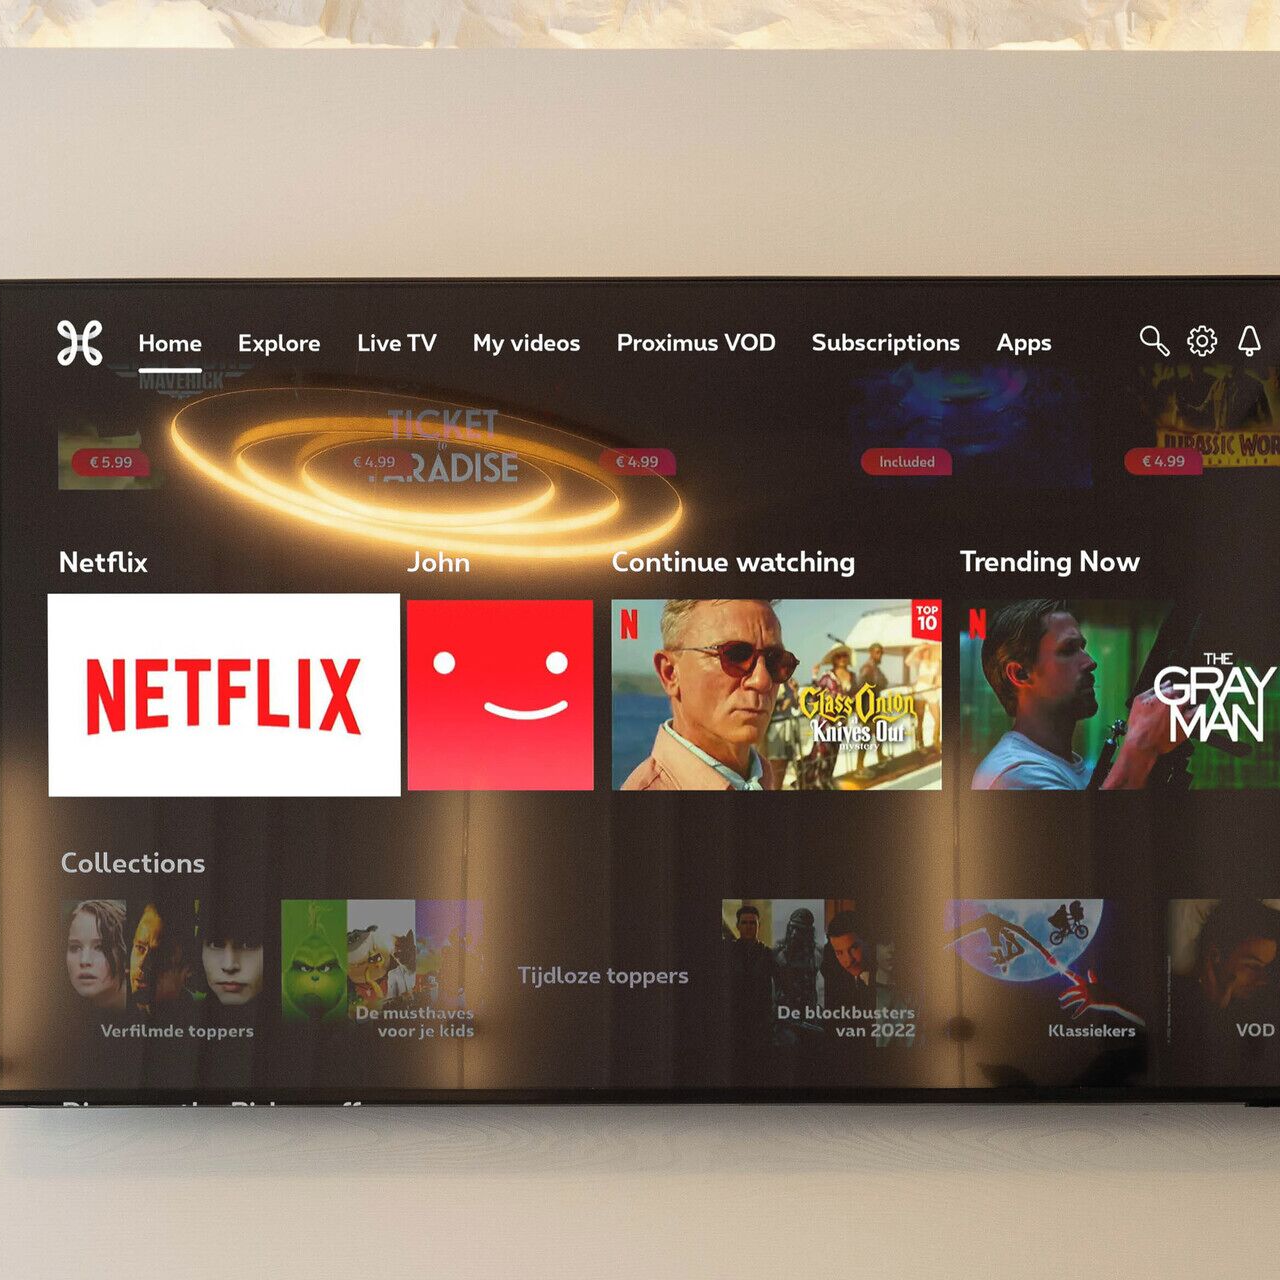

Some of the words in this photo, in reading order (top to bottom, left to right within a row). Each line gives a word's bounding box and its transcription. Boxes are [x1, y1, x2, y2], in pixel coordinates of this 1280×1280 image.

[138, 334, 202, 352] Home
[238, 333, 321, 357] Explore
[357, 333, 401, 352] Live
[407, 333, 437, 352] TV
[473, 333, 505, 356] My
[510, 333, 581, 352] videos
[617, 333, 718, 352] Proximus
[724, 333, 776, 352] VOD
[811, 332, 960, 357] Subscriptions
[996, 333, 1052, 356] Apps
[139, 372, 224, 389] MAVERICK
[387, 409, 498, 440] TICKET
[90, 456, 98, 469] €
[102, 455, 132, 469] 5.99
[365, 456, 396, 468] 4.99
[368, 452, 517, 483] RADISE
[616, 456, 624, 467] €
[628, 455, 659, 467] 4.99
[879, 455, 935, 468] Included
[1142, 456, 1151, 467] €
[1155, 455, 1185, 467] 4.99
[59, 551, 148, 573] Netflix
[407, 552, 470, 573] John
[612, 551, 728, 573] Continue
[736, 551, 856, 577] watching
[960, 550, 1071, 577] Trending
[1080, 550, 1141, 573] Now
[916, 605, 939, 615] TOP
[916, 615, 938, 631] 10
[1203, 652, 1233, 666] THE
[87, 659, 361, 735] NETFLIX
[1154, 666, 1278, 710] GRAY
[800, 687, 854, 722] Glass
[855, 682, 918, 724] Onion
[810, 719, 871, 743] Knives
[876, 720, 905, 742] Out
[1170, 704, 1265, 742] MAN
[839, 742, 880, 752] mystery
[61, 852, 206, 874] Collections
[518, 966, 601, 989] Tijdloze
[607, 966, 689, 989] toppers
[357, 1007, 378, 1020] De
[383, 1006, 475, 1021] musthaves
[778, 1006, 801, 1020] De
[805, 1005, 915, 1021] blockbusters
[101, 1023, 184, 1038] Verfilmde
[188, 1025, 255, 1041] toppers
[378, 1026, 416, 1038] voor
[419, 1024, 434, 1040] je
[440, 1024, 475, 1038] kids
[835, 1026, 867, 1038] van
[871, 1024, 916, 1038] 2022
[1048, 1023, 1136, 1038] Klassiekers
[1236, 1023, 1275, 1038] VOD
